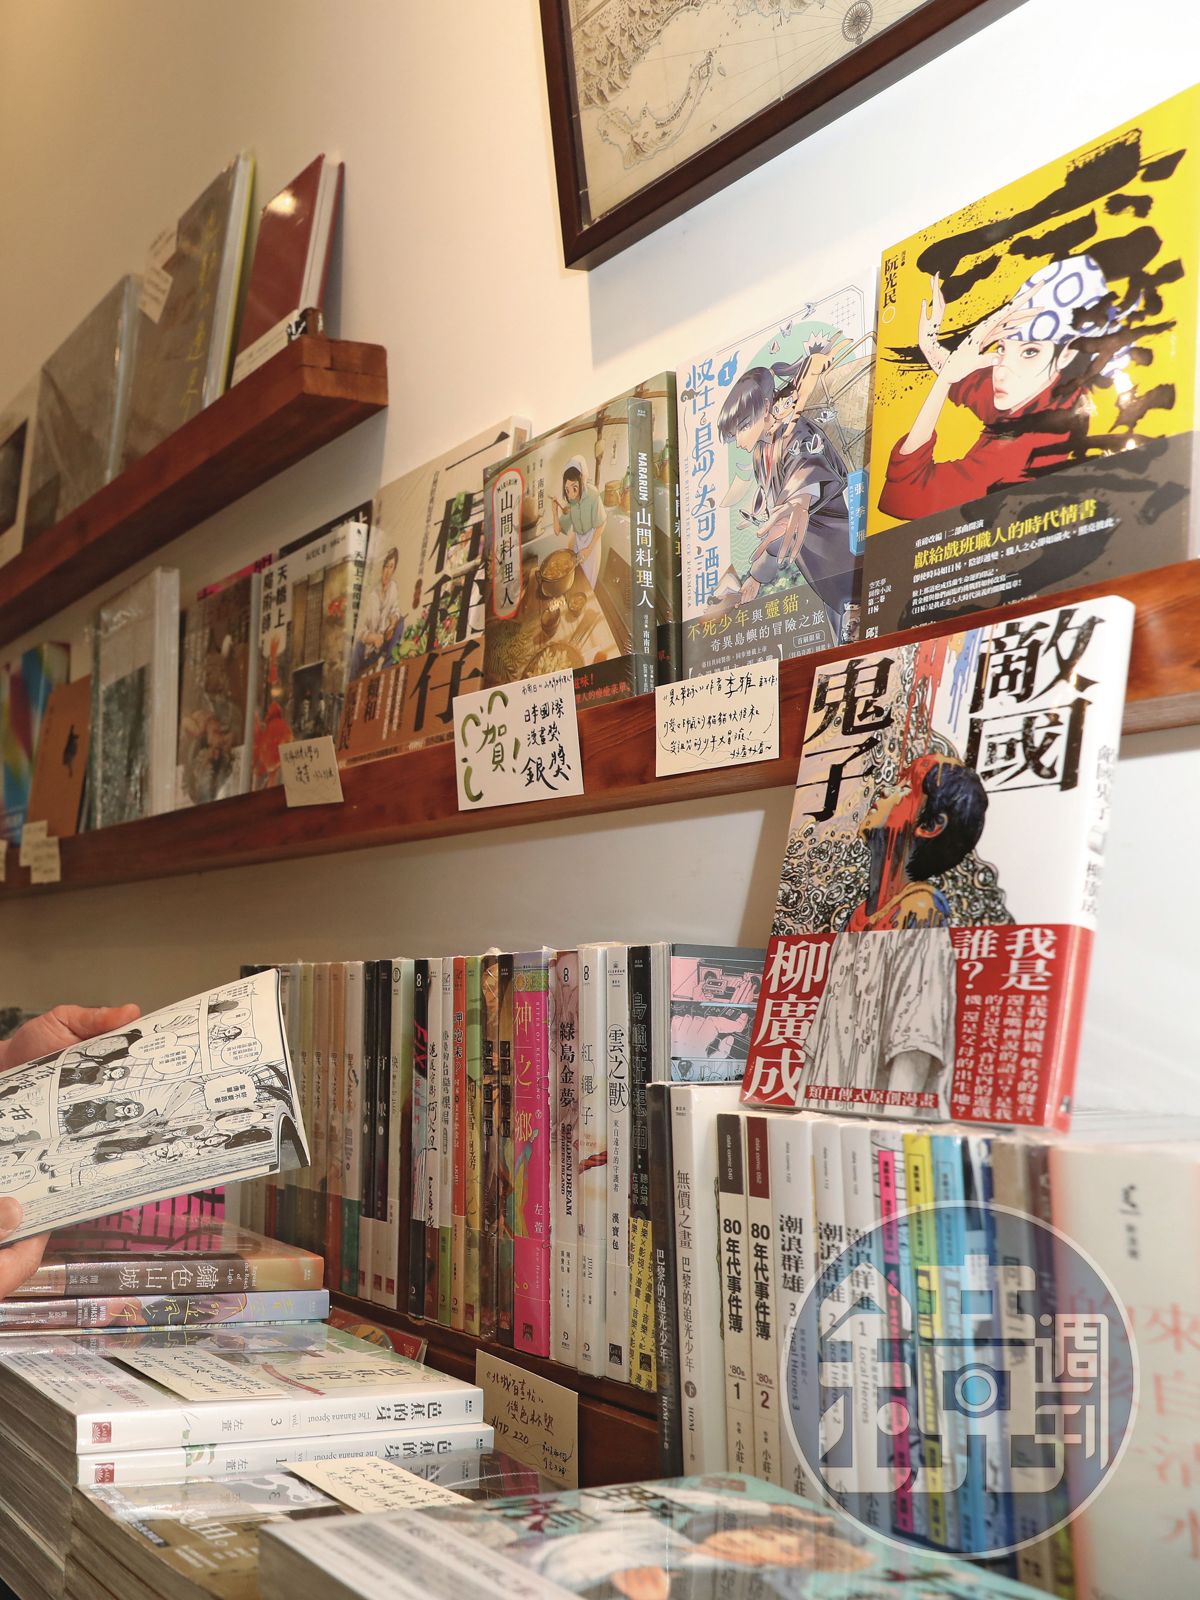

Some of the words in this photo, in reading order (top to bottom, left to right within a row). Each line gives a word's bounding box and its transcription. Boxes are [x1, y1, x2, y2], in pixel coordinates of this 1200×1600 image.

[883, 255, 899, 308] 阮光民
[638, 452, 648, 501] MARARUM
[500, 489, 516, 609] 山間料理人
[636, 507, 655, 609] 山間料理人
[913, 499, 1097, 570] 獻給戲班職人的時代情書
[642, 630, 651, 654] 南南日
[711, 612, 826, 652] 奇異島嶼的冒險之旅
[968, 608, 1107, 794] 敵國
[795, 658, 895, 823] 鬼子
[520, 744, 572, 791] 銀獎
[1000, 928, 1057, 991] 我是
[744, 940, 831, 1103] 柳廣成
[514, 1002, 533, 1143] 神之鄉
[560, 1021, 576, 1108] 綠島金夢
[581, 1043, 597, 1126] 紅繩子
[608, 1028, 627, 1108] 雲之獸
[566, 1124, 574, 1167] GOLDEN
[564, 1169, 573, 1216] DREAM
[676, 1169, 693, 1250] 無價之畫
[534, 1203, 543, 1234] 左萱
[118, 1264, 221, 1291] 鏽色山城
[723, 1218, 743, 1334] 80年代事件簿
[779, 1214, 805, 1293] 潮浪群雄
[819, 1221, 847, 1303] 潮浪群雄
[846, 1227, 877, 1312] 潮浪群雄
[656, 1248, 669, 1364] 巴黎的追光少年
[751, 1223, 771, 1341] 80年代事件簿
[682, 1256, 696, 1373] 巴黎的追光少年
[789, 1302, 797, 1317] 3
[376, 1401, 443, 1421] 芭蕉的芽
[733, 1382, 741, 1399] 1
[761, 1391, 770, 1409] 2
[222, 1418, 244, 1432] 左萱
[270, 1417, 282, 1426] 3
[308, 1414, 330, 1423] Sprout
[332, 1412, 357, 1421] Banana
[513, 1430, 529, 1444] 220
[225, 1458, 248, 1471] 左萱
[384, 1440, 452, 1460] 芭蕉的芽
[735, 1439, 745, 1464] 小莊
[762, 1450, 772, 1474] 小莊
